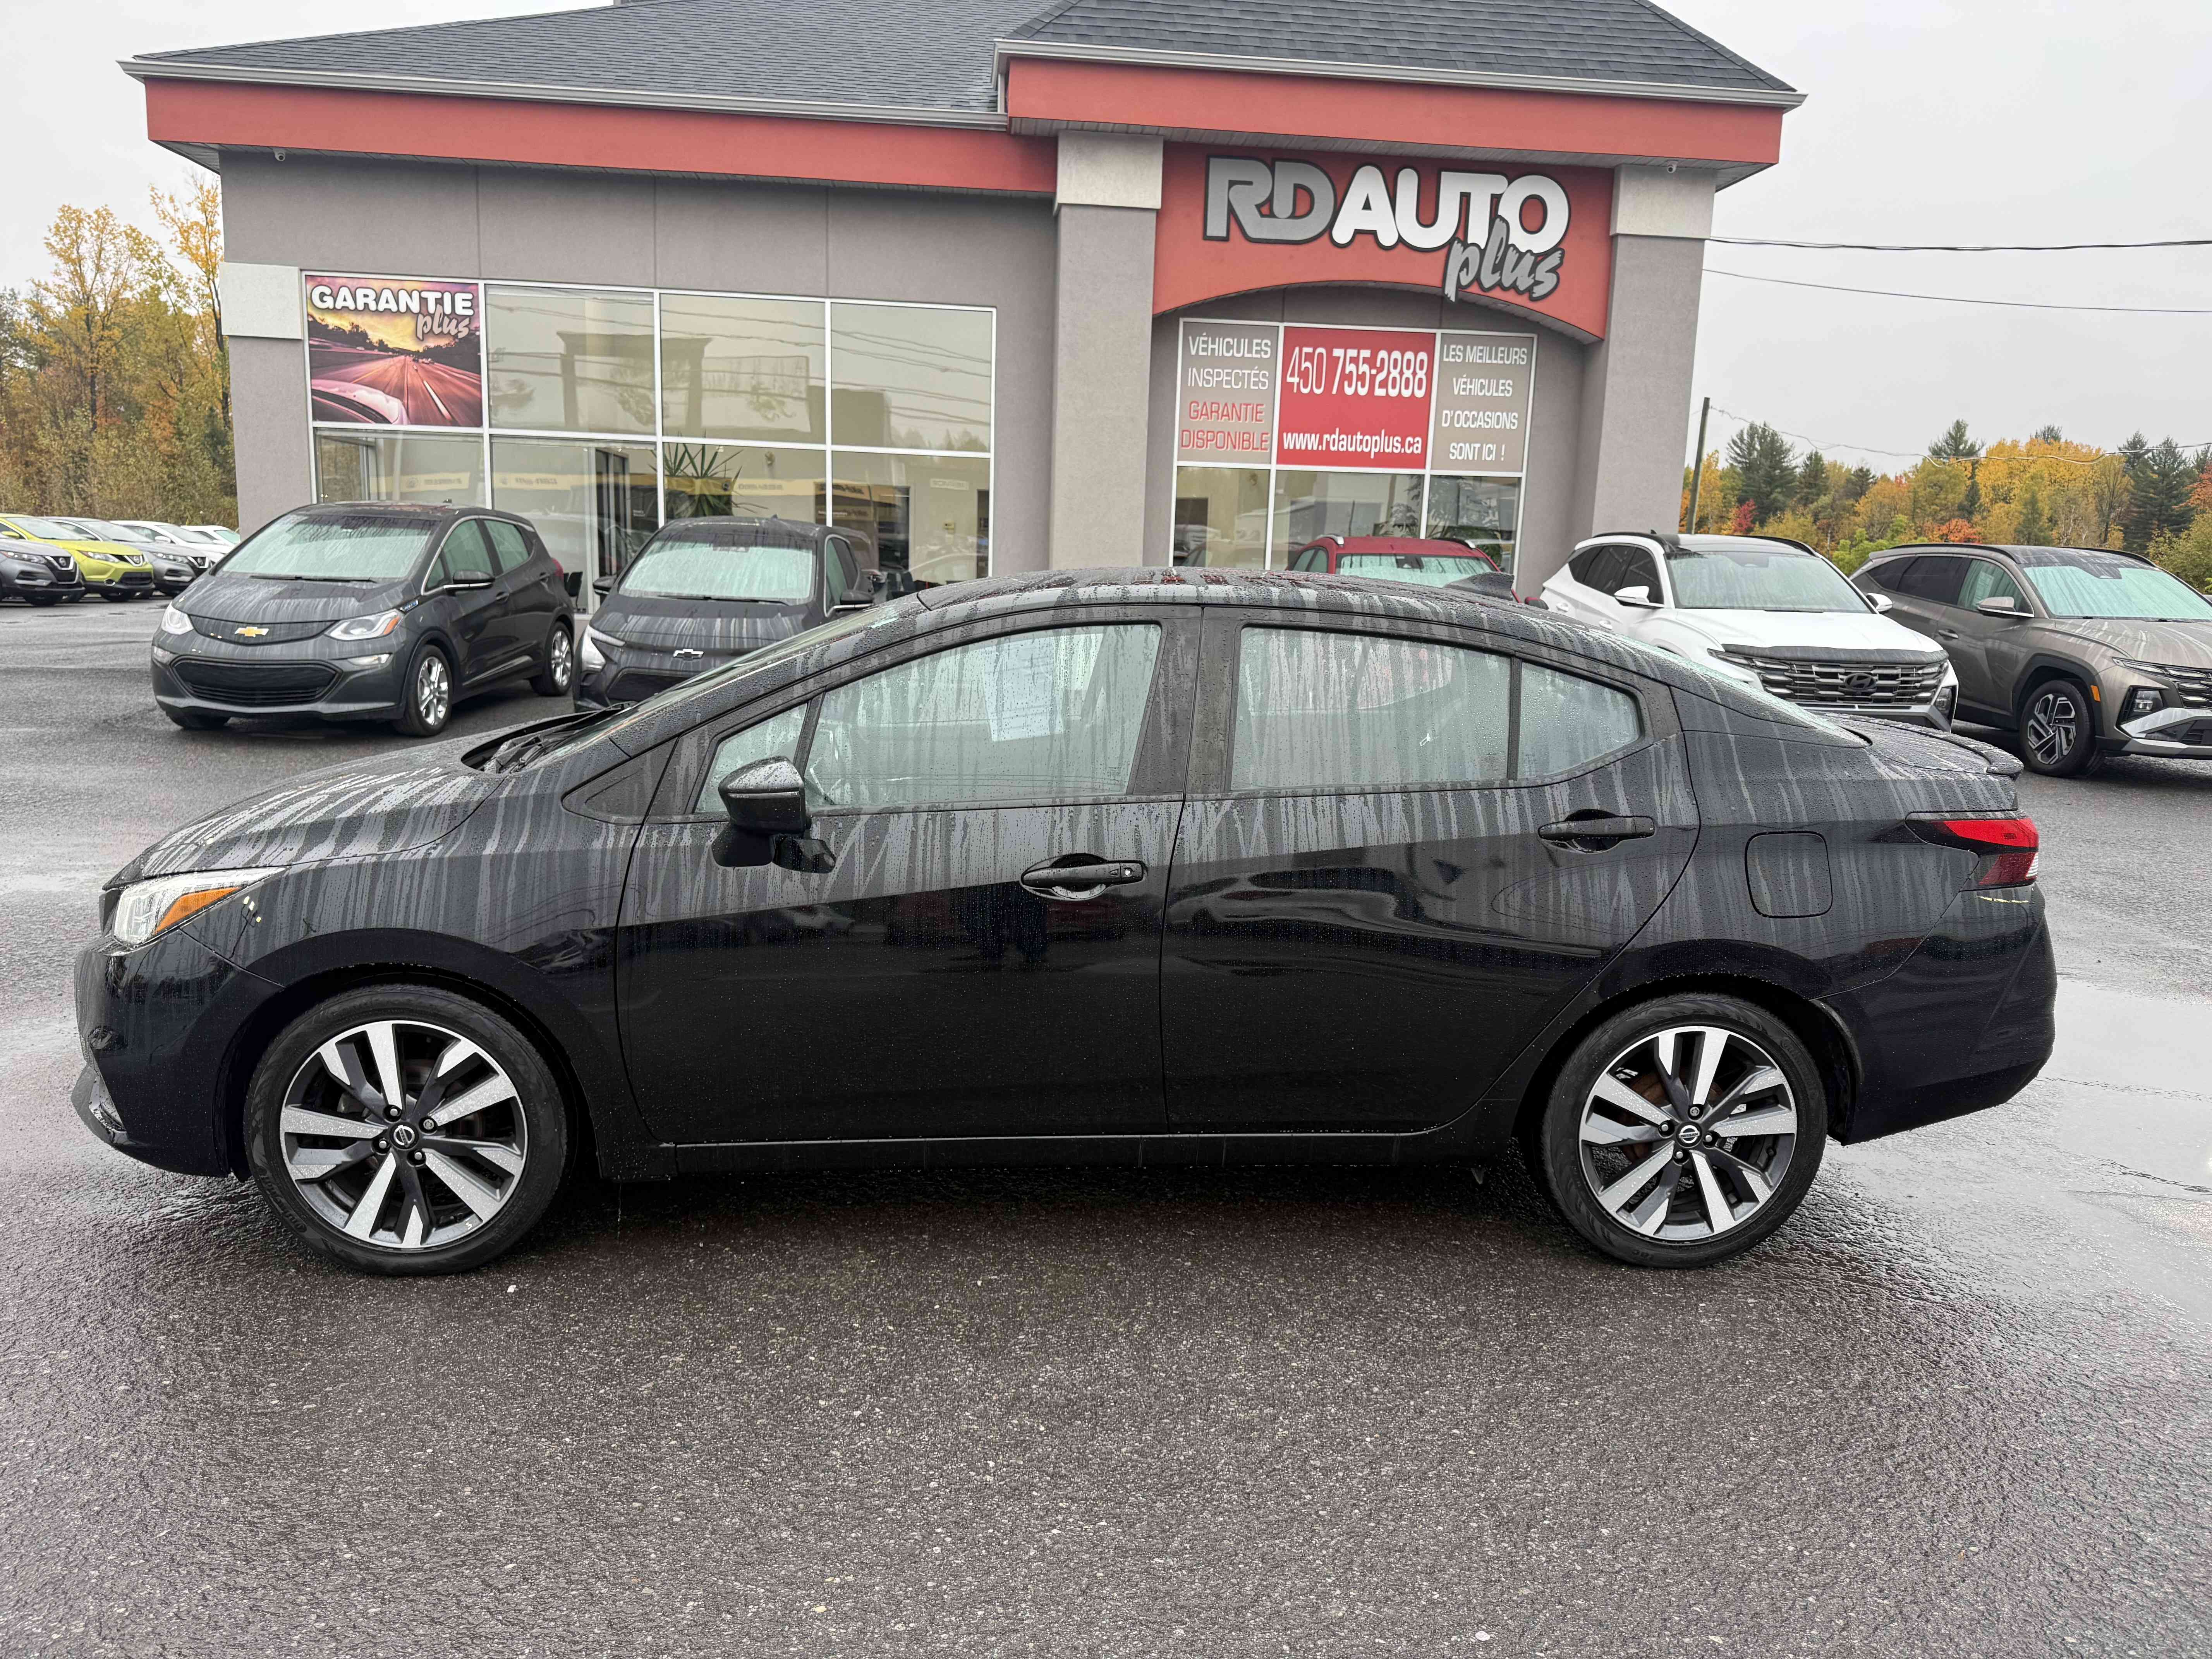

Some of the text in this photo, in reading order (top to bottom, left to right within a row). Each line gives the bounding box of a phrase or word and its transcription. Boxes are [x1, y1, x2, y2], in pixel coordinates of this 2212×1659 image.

[1444, 216, 1563, 302] plus
[311, 285, 474, 316] GARANTIE
[416, 304, 471, 341] plus
[1188, 332, 1271, 358] VÉHICULES
[1443, 344, 1527, 365] LES MEILLEURS
[1187, 366, 1269, 390] INSPECTÉS
[1286, 347, 1428, 398] 450 755-2888
[1453, 373, 1513, 397] VÉHICULES
[1189, 400, 1265, 423] GARANTIE
[1181, 429, 1271, 452] DISPONIBLE
[1283, 427, 1422, 459] www.rdautoplus.ca
[1449, 443, 1481, 460] SONT
[1482, 443, 1496, 461] ICI
